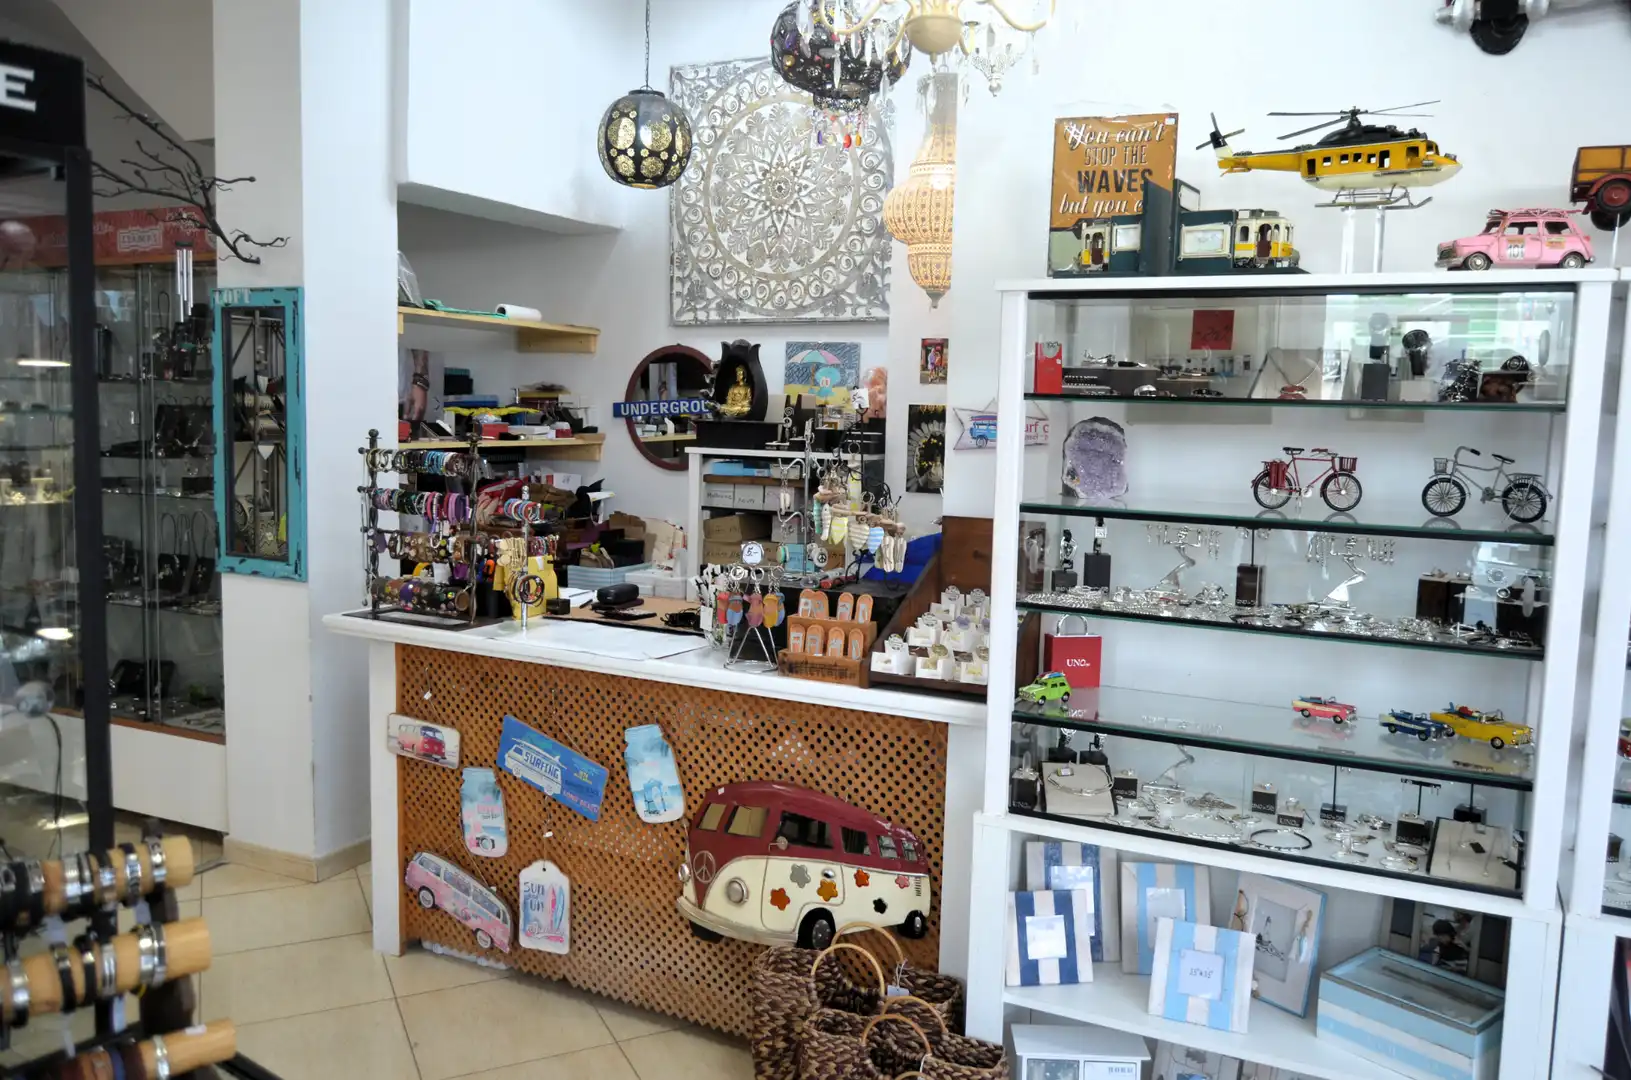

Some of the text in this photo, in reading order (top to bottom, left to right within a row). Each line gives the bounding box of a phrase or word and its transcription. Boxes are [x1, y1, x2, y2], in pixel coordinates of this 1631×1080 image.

[1063, 121, 1165, 150] You can't
[1084, 144, 1148, 166] STOP THE
[1077, 168, 1154, 194] WAVES
[1059, 193, 1089, 214] but
[1092, 199, 1129, 218] you
[213, 288, 252, 304] LOFT
[620, 399, 710, 416] UNDERGROU
[1024, 420, 1040, 433] urf
[523, 751, 561, 780] SURFING
